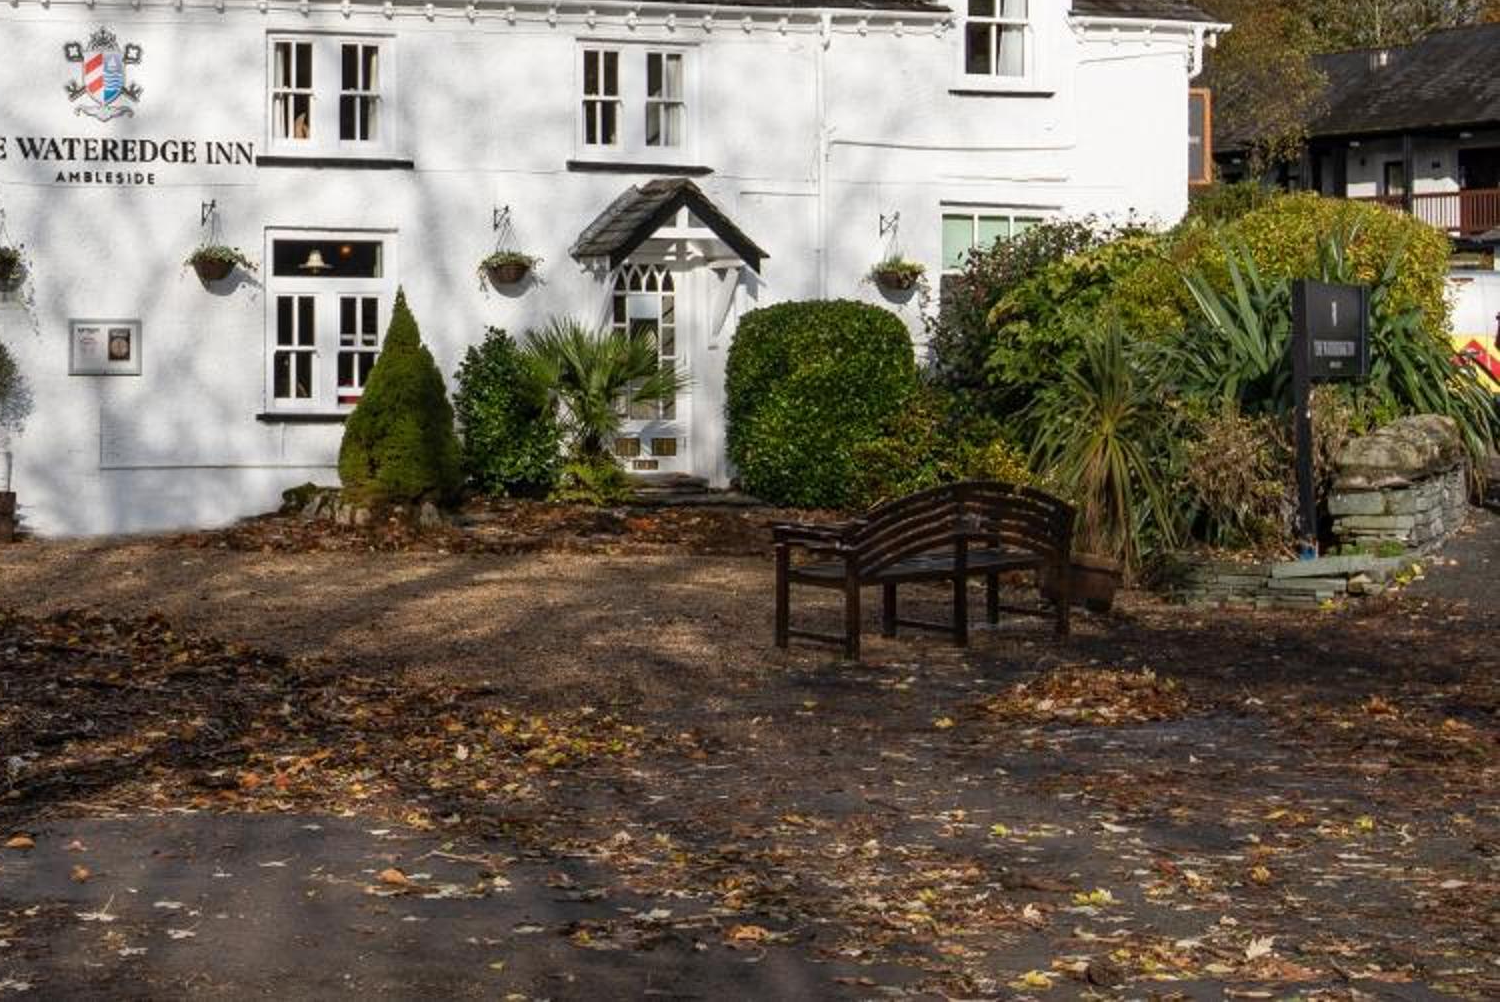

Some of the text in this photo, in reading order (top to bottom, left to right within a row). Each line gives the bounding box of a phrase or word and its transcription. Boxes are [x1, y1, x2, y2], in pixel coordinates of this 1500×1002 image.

[16, 137, 197, 163] WATEREDGE
[206, 142, 253, 165] INN
[56, 171, 156, 185] AMBLESIDE
